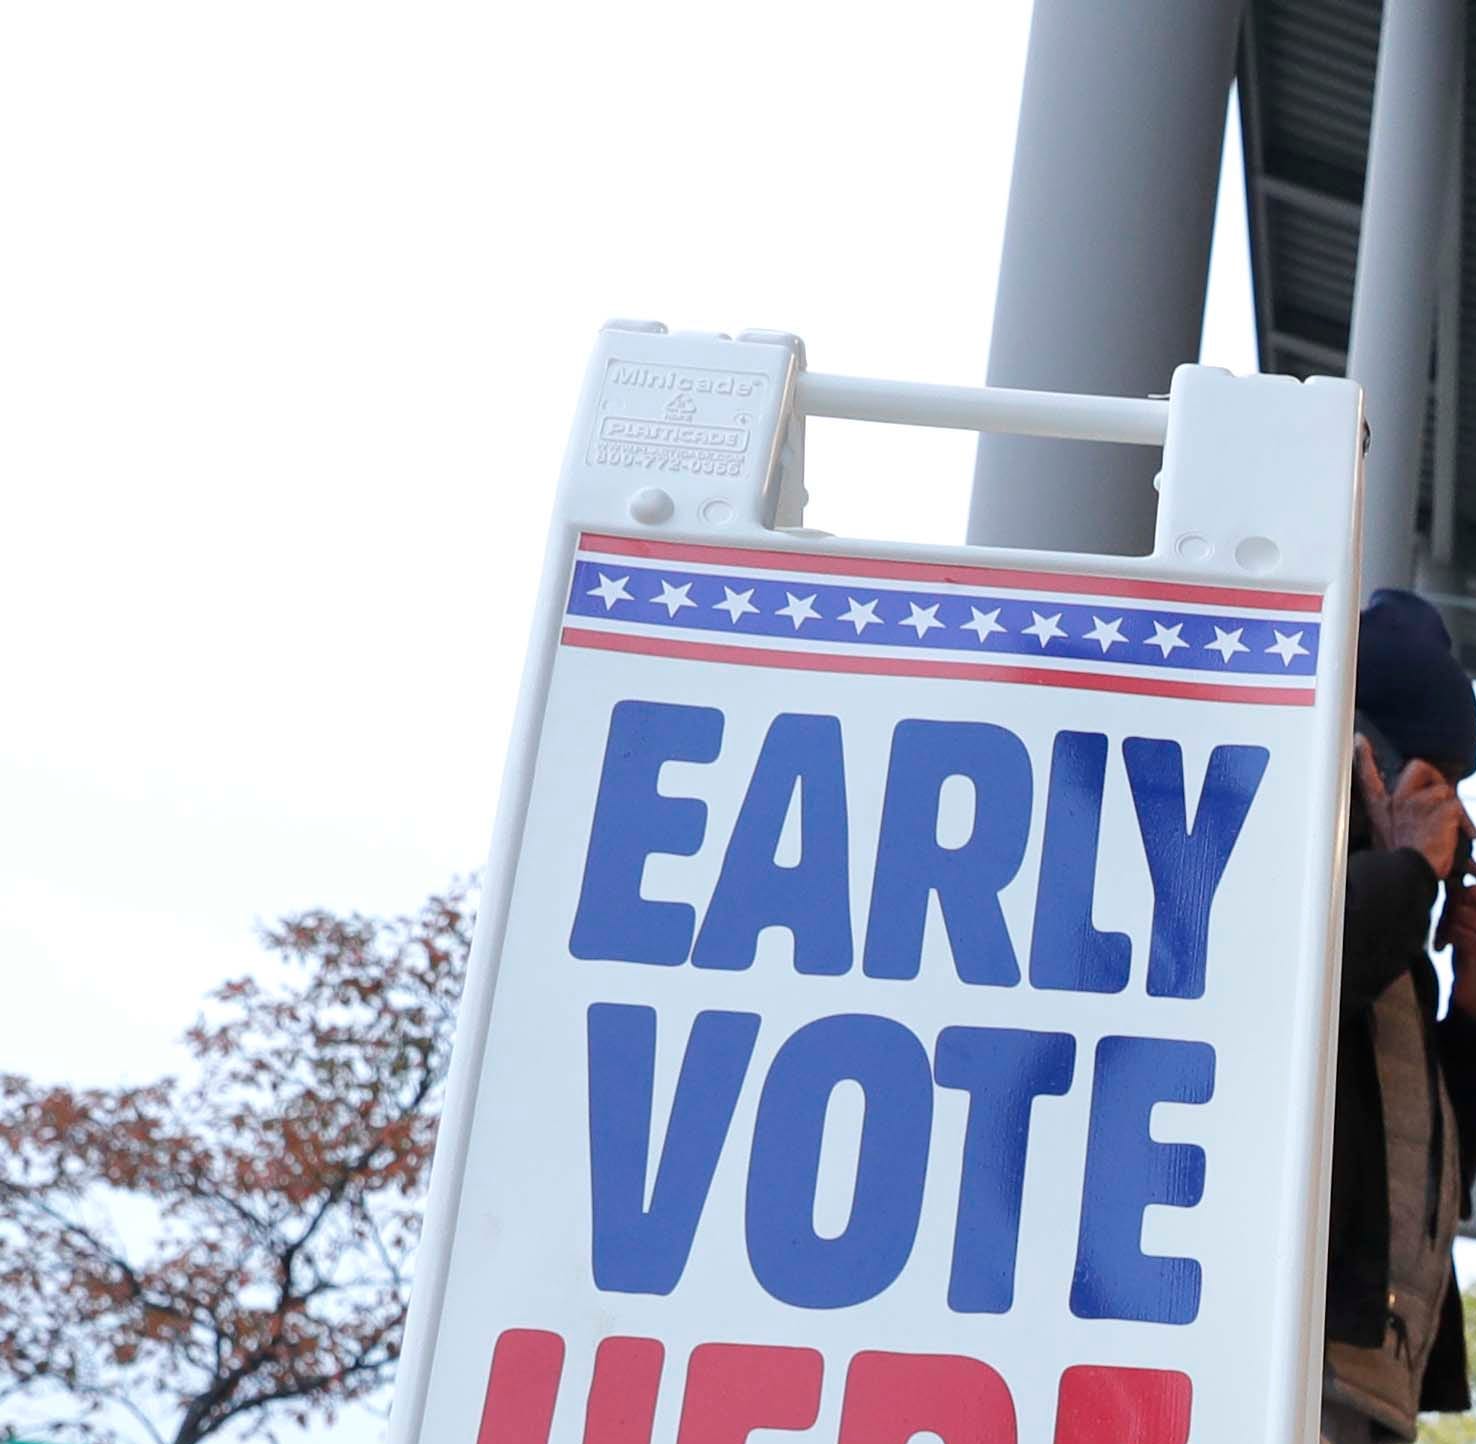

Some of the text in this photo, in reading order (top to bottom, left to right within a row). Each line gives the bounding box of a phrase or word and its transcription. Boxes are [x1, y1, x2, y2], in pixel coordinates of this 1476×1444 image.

[607, 421, 740, 448] PLASTICADE
[569, 699, 1271, 1001] EARLY
[587, 1002, 1217, 1326] VOTE
